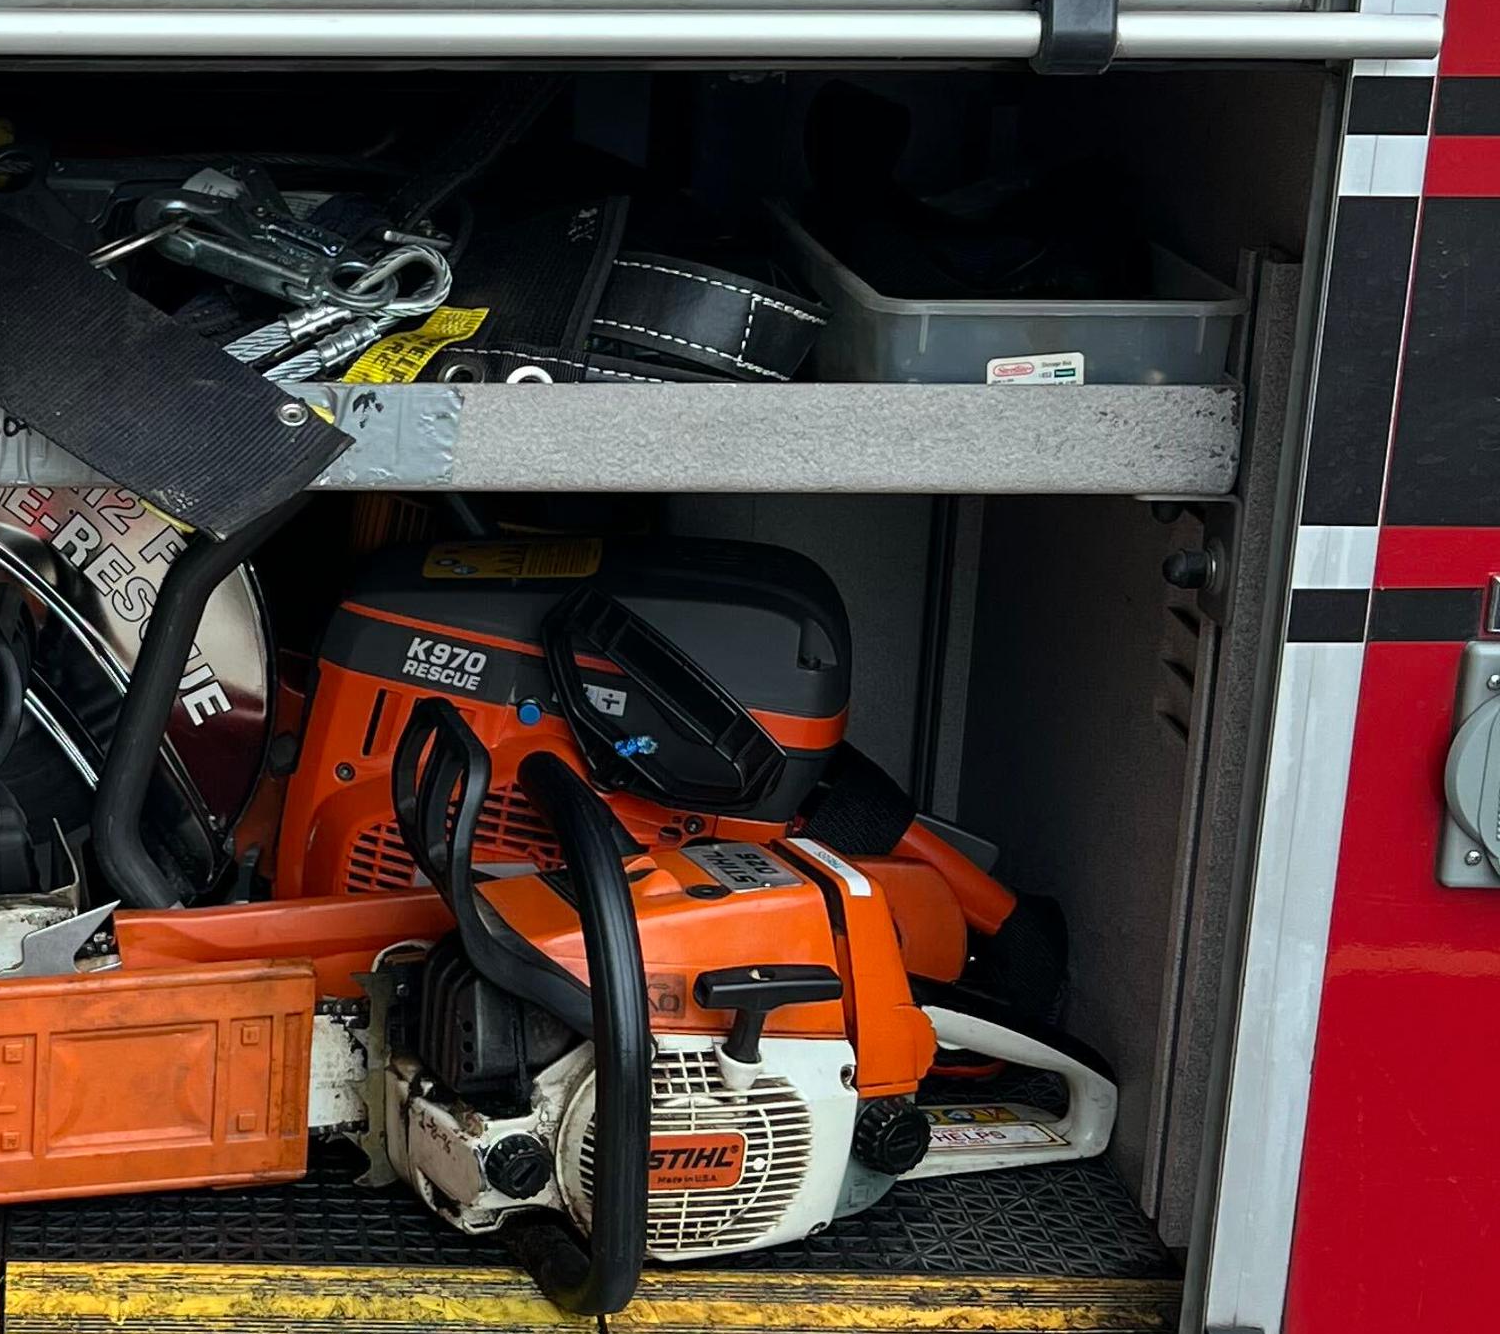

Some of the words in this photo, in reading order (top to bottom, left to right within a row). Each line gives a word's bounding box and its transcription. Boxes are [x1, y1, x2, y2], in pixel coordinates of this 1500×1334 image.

[407, 636, 487, 674] K970
[402, 659, 481, 691] RESCUE
[703, 851, 758, 888] STIHL
[930, 1129, 1007, 1142] HELPS
[648, 1147, 734, 1170] STIHL
